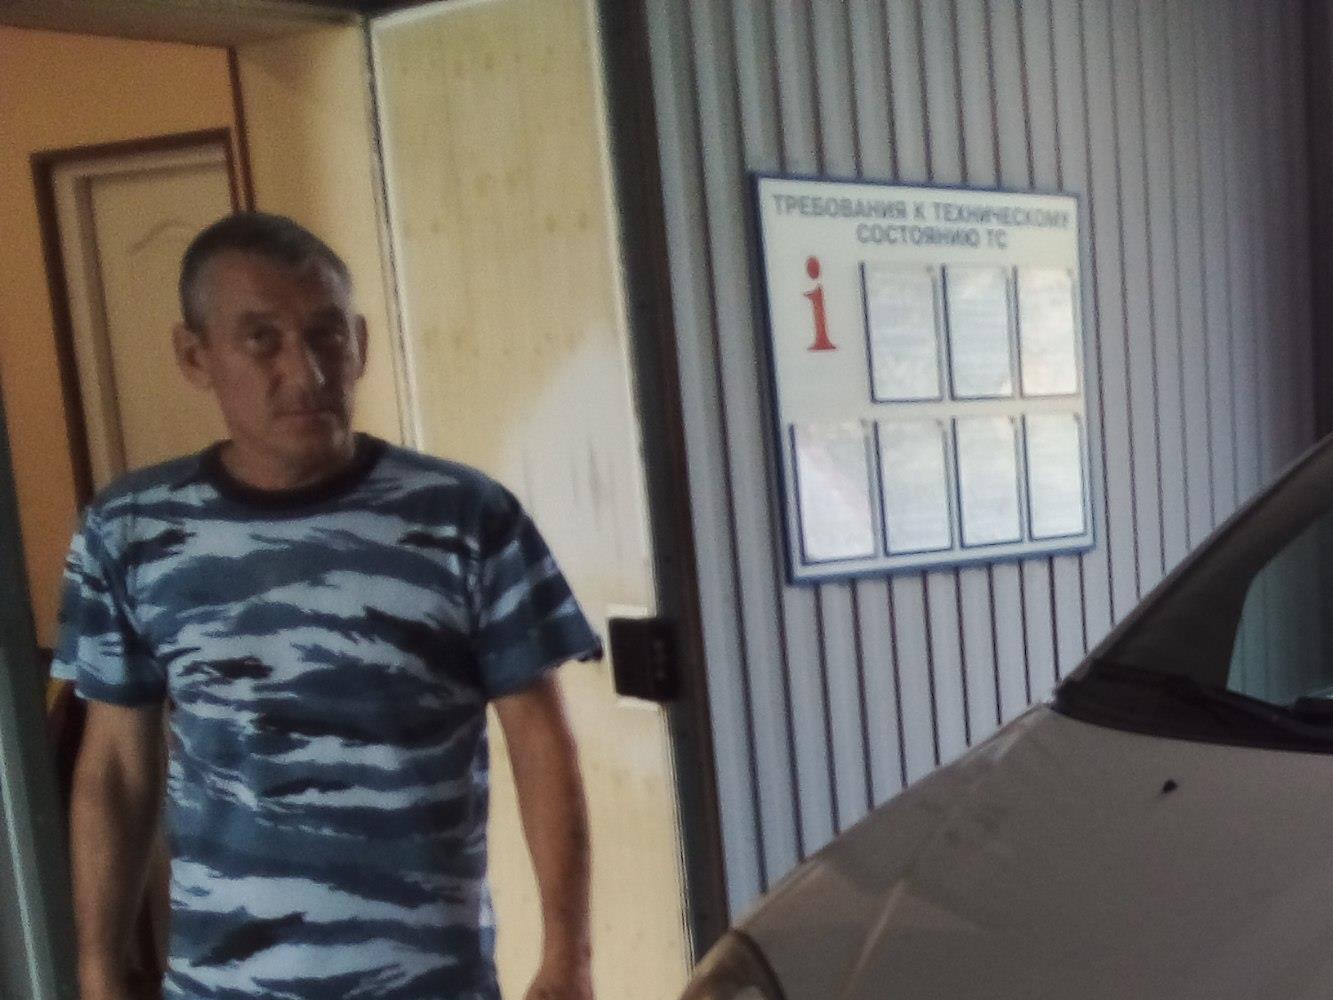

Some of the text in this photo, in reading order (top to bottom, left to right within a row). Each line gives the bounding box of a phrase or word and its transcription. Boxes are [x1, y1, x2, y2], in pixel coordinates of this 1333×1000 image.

[773, 194, 1071, 229] ТРЕБОВАНИЯ К ТЕХНИЧЕСКОМУ
[856, 222, 1009, 250] СОСТОЯНИЮ ТС
